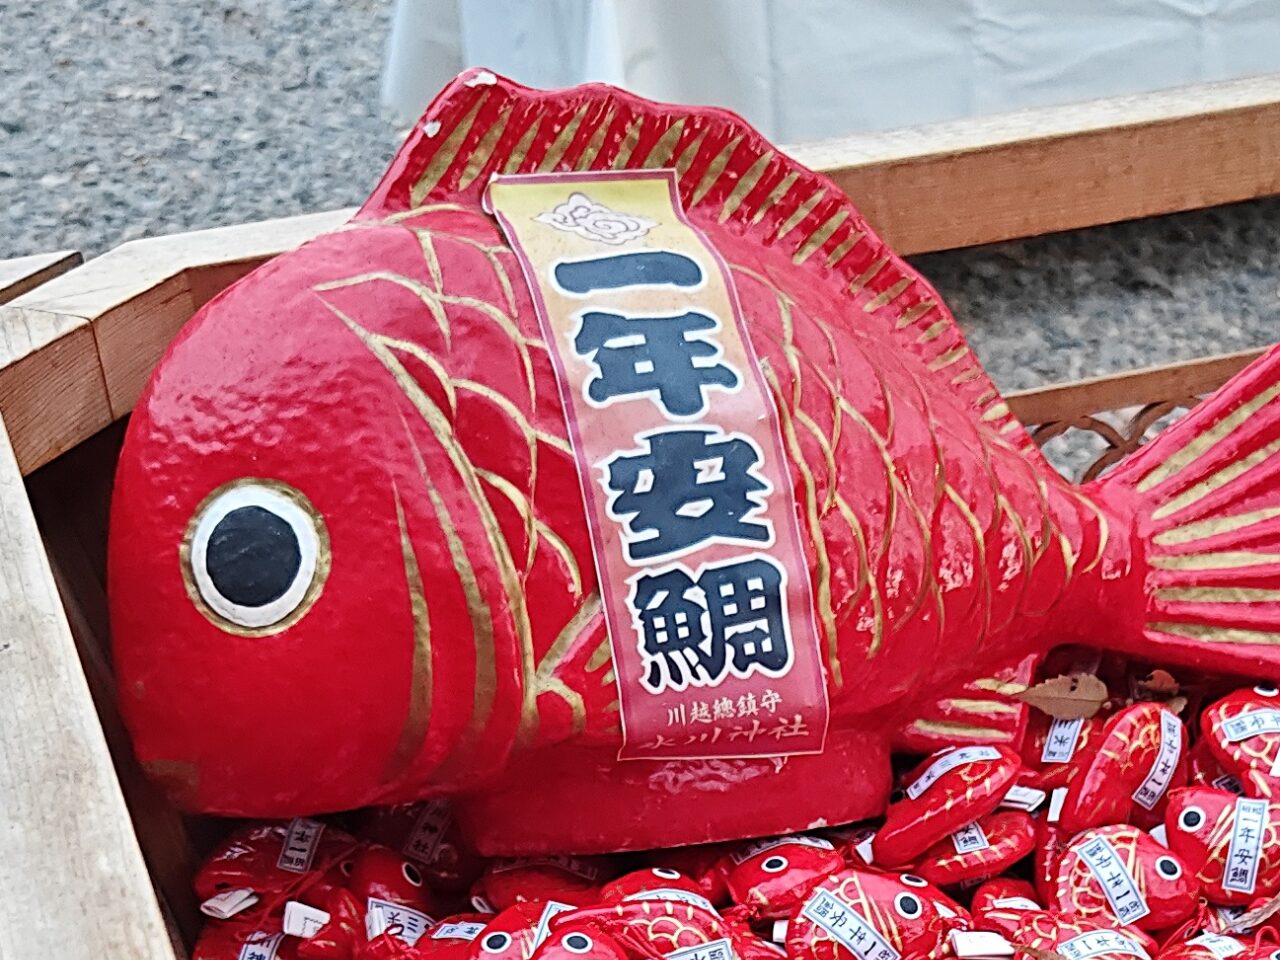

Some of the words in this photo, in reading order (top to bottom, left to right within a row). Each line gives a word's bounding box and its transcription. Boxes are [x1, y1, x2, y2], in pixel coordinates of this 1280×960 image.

[552, 249, 793, 692] 一年安鯛
[667, 689, 782, 727] 川越總鎮守
[1229, 817, 1259, 885] 一年安鯛
[813, 895, 877, 955] 一年安鯛
